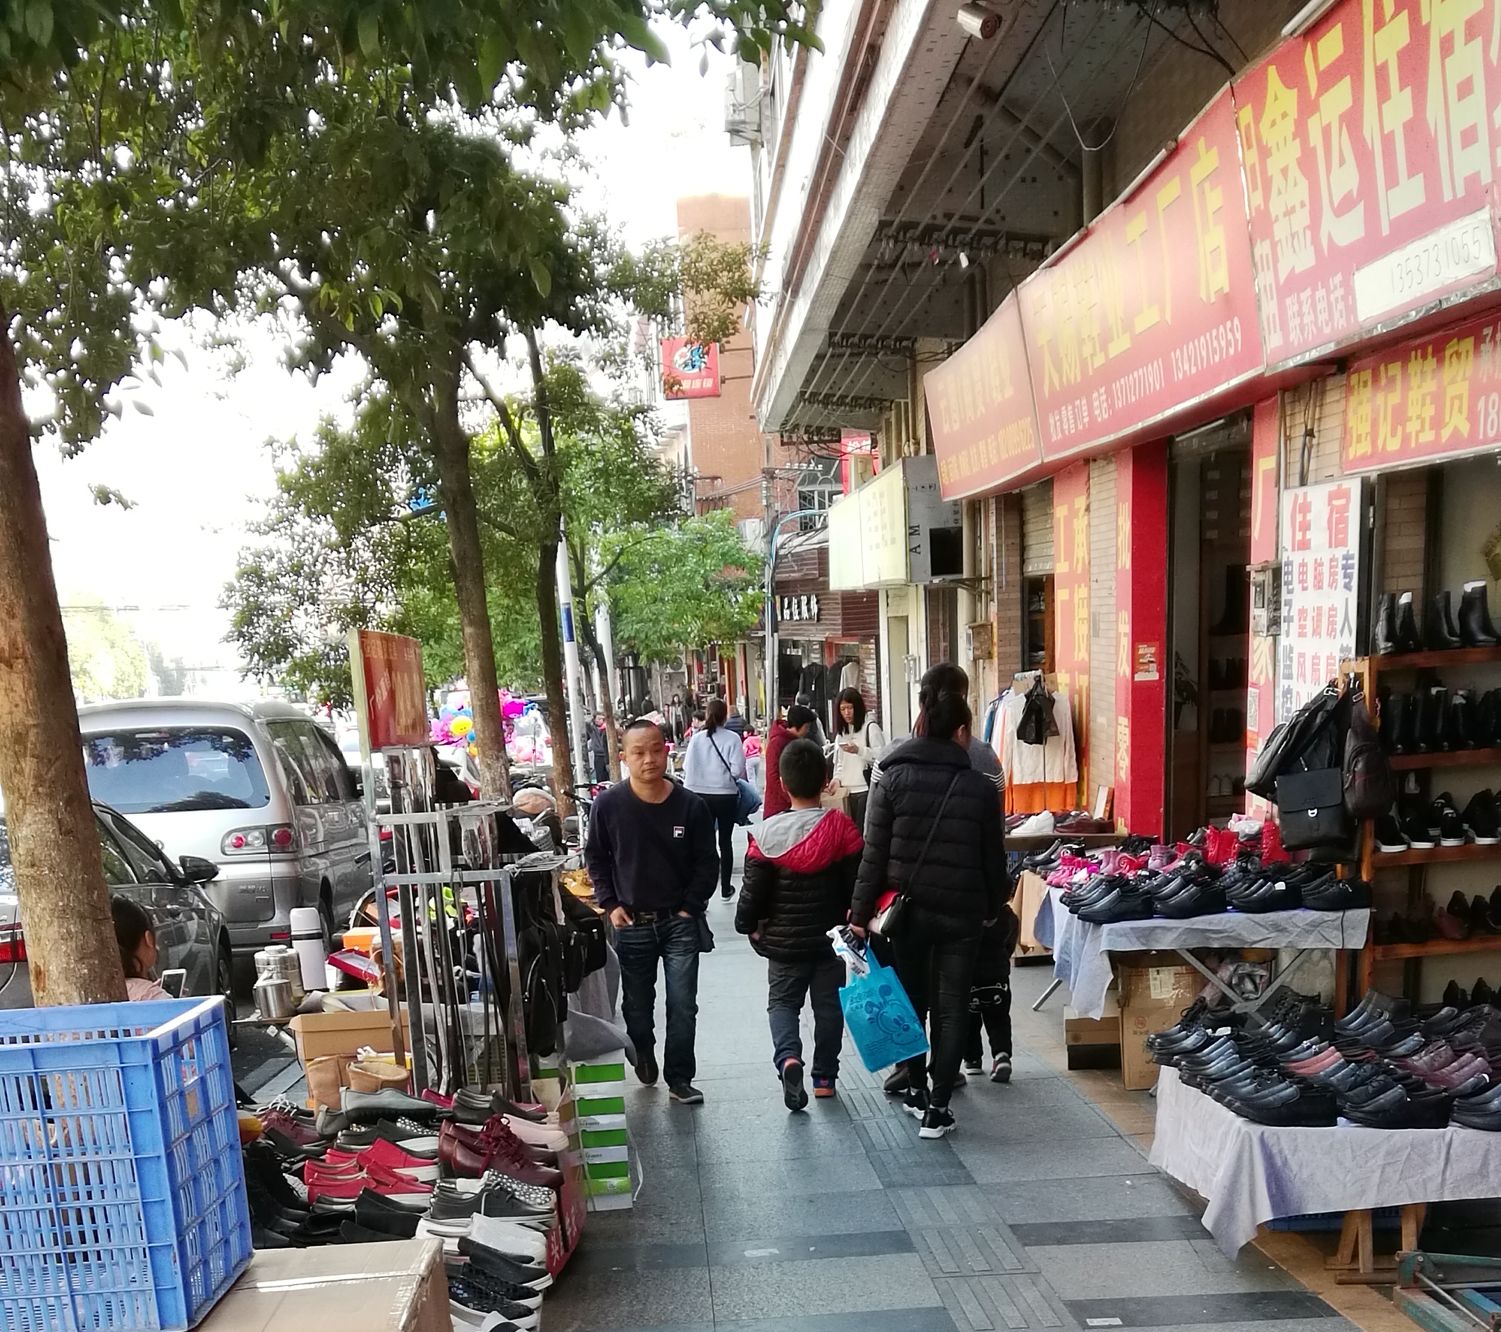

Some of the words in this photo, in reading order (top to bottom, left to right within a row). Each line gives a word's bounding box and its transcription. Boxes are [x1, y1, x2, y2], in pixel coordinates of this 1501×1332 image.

[1171, 316, 1242, 382] 13421915959
[1348, 336, 1474, 461] 强记鞋贸
[1289, 483, 1352, 553] 住宿
[1297, 553, 1339, 592] 电脑房
[1297, 602, 1339, 641] 空调房
